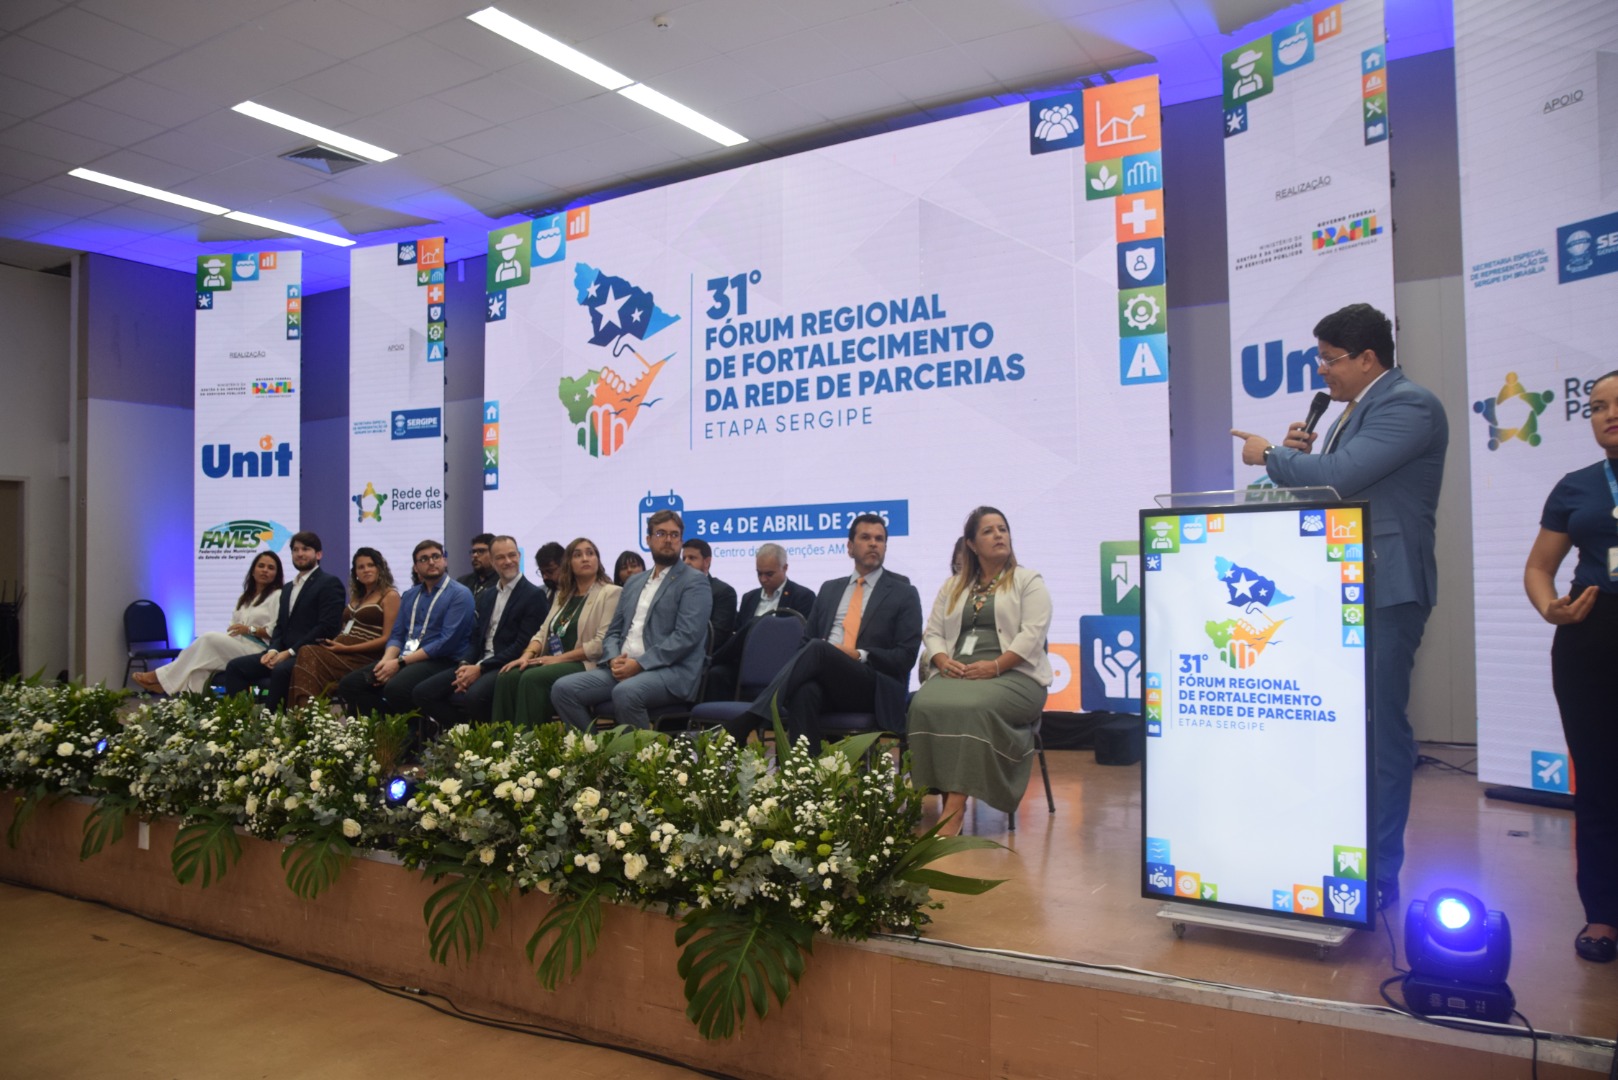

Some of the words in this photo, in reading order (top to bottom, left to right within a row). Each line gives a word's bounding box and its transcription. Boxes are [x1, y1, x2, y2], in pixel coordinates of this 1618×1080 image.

[1543, 89, 1584, 114] APOIO
[1275, 175, 1331, 199] REALIZAÇÃO
[1312, 215, 1383, 251] BRASIL
[705, 314, 794, 351] FÓRUM
[801, 293, 947, 337] REGIONAL
[705, 355, 736, 382] DE
[742, 321, 994, 377] FORTALECIMENTO
[1241, 339, 1328, 399] Un
[252, 381, 295, 395] BRASIL
[705, 386, 739, 412] DA
[745, 377, 810, 408] REDE
[816, 372, 851, 401] DE
[858, 352, 1026, 396] PARCERIAS
[406, 416, 438, 427] SERGIPE
[704, 416, 768, 439] ETAPA
[776, 406, 873, 433] SERGIPE
[201, 435, 293, 479] Unit
[391, 488, 422, 499] Rede
[425, 486, 440, 498] de
[391, 497, 442, 511] Parcerias
[696, 519, 706, 536] 3
[710, 522, 719, 535] e
[723, 518, 733, 535] 4
[737, 516, 758, 534] DE
[762, 514, 814, 533] ABRIL
[819, 512, 842, 530] DE
[846, 510, 889, 529] 25
[200, 530, 261, 549] FAMES
[713, 546, 746, 558] Centro
[785, 544, 825, 559] venções
[827, 543, 846, 555] AM
[1178, 673, 1226, 688] FÓRUM
[1229, 677, 1300, 691] REGIONAL
[1178, 690, 1195, 701] DE
[1198, 690, 1322, 707] FORTALECIMENTO
[1178, 703, 1197, 715] DA
[1200, 704, 1234, 717] REDE
[1237, 706, 1255, 718] DE
[1258, 707, 1337, 722] PARCERIAS
[1178, 717, 1213, 728] ETAPA
[1216, 719, 1265, 731] SERGIPE
